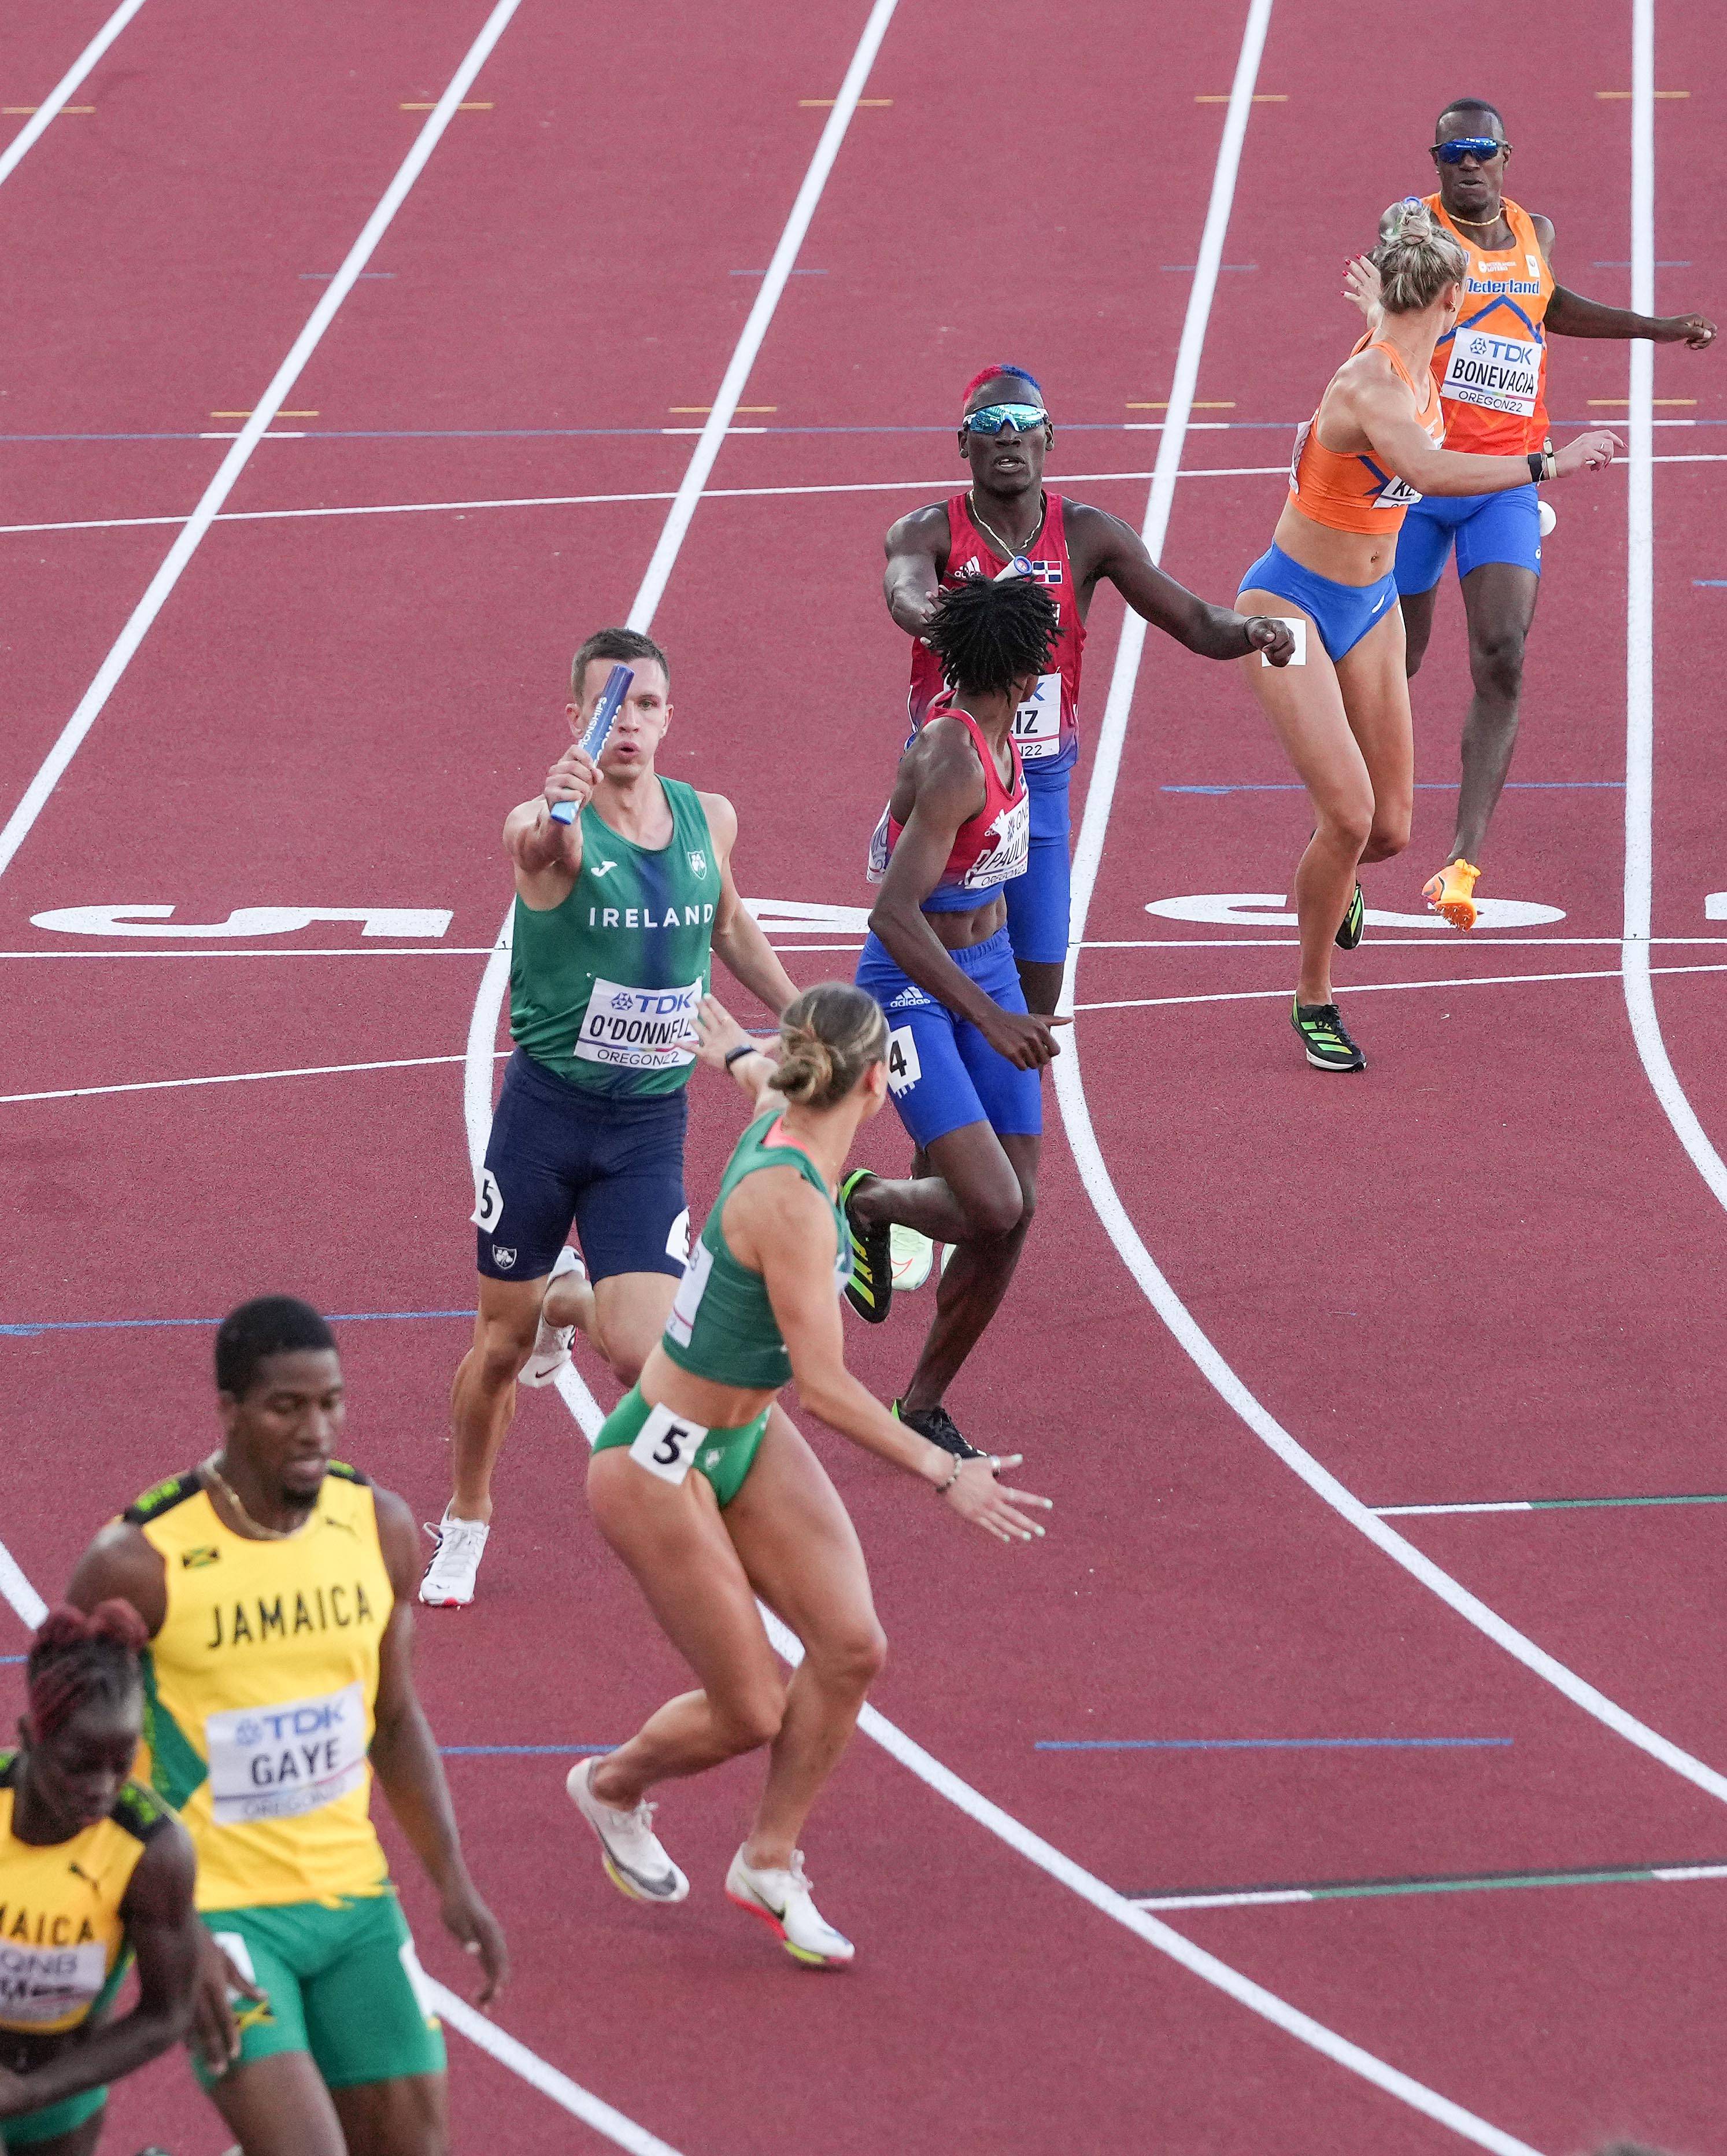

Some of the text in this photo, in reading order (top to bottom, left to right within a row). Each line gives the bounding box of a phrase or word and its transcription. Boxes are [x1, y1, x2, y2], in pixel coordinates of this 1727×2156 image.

[1488, 339, 1533, 366] TDK
[1452, 357, 1534, 394] BONEVACIA
[1458, 390, 1523, 412] OREGON22
[29, 903, 454, 938] 5
[589, 903, 714, 928] IRELAND
[636, 990, 696, 1014] TDK
[597, 1049, 680, 1066] OREGON22
[889, 1040, 908, 1077] 4
[480, 1178, 494, 1219] 5
[652, 1424, 690, 1465] 5
[208, 1582, 373, 1651] JAMAICA
[262, 1697, 347, 1740] TDK
[250, 1737, 341, 1787] GAYE
